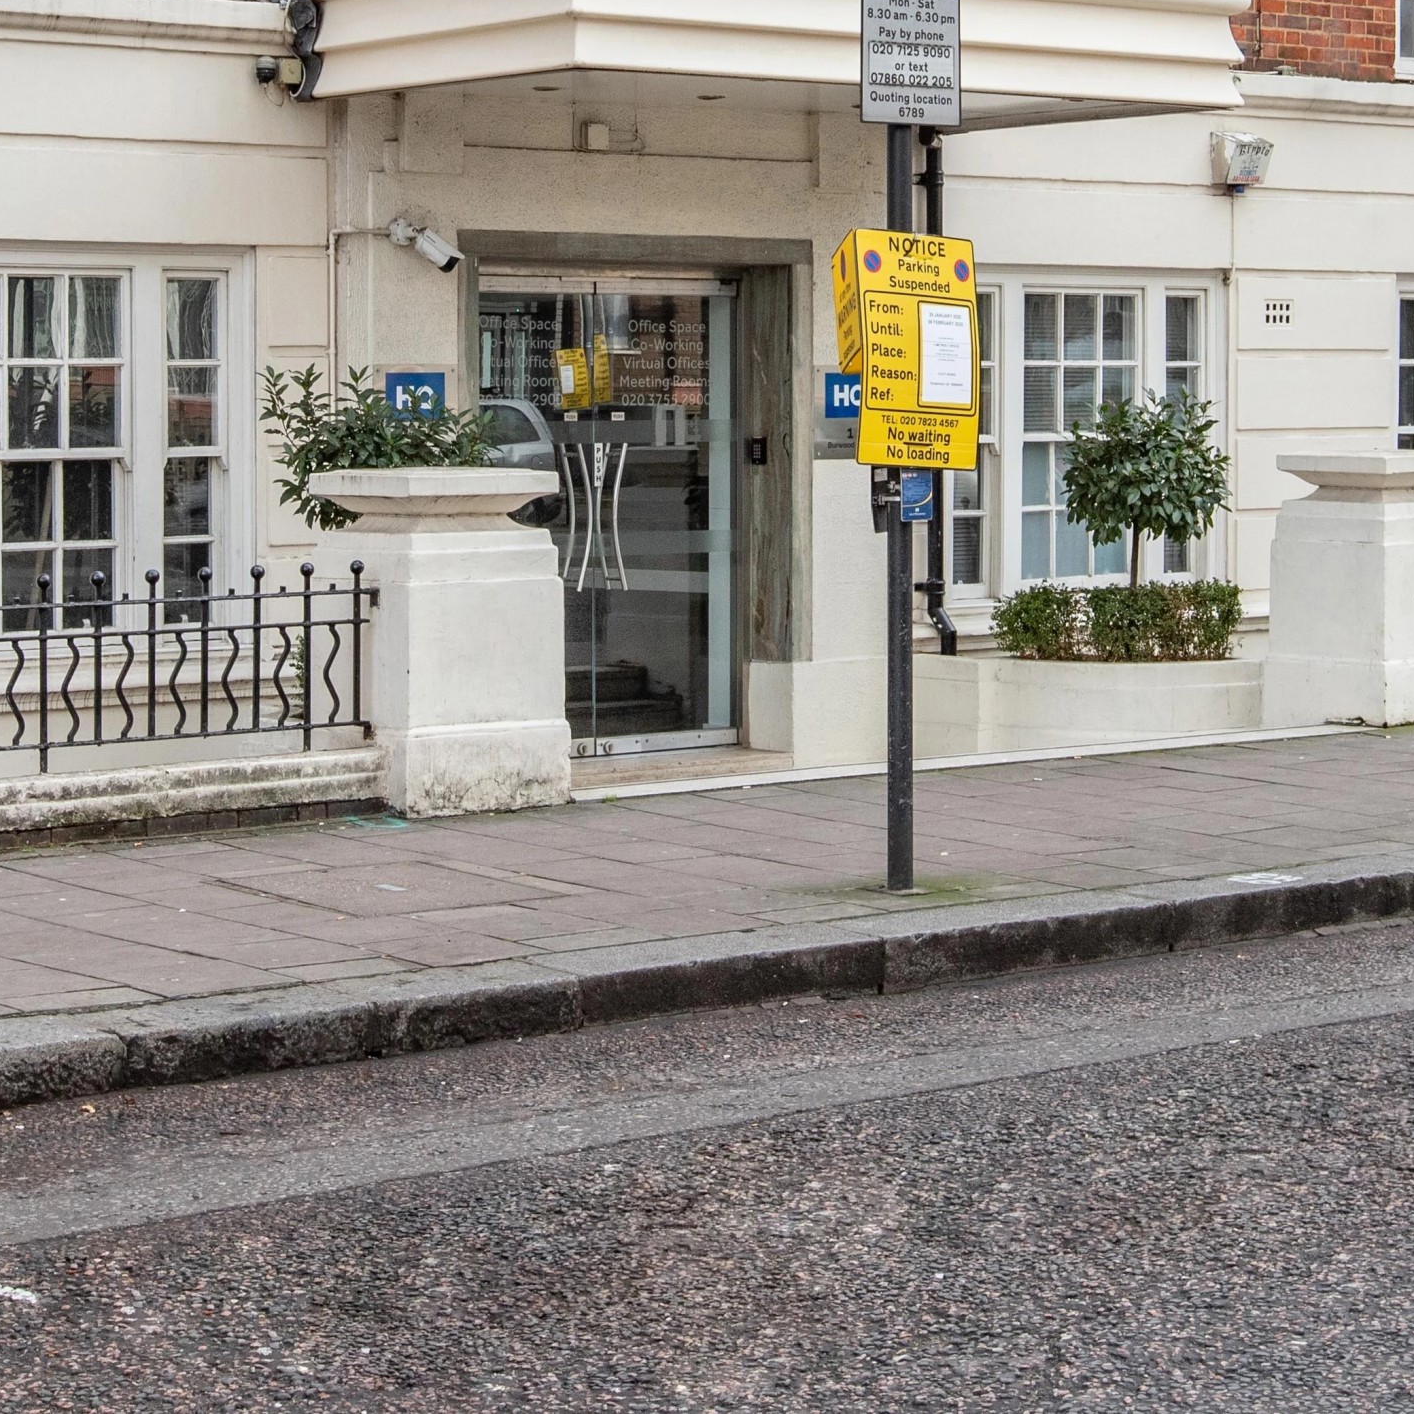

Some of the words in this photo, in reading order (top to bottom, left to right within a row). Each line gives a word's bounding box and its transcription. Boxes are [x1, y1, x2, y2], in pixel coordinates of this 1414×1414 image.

[867, 8, 891, 20] 8.30
[893, 13, 908, 21] am
[915, 11, 939, 24] 6.30
[940, 16, 956, 26] pm
[879, 27, 897, 40] Pay
[900, 28, 912, 41] by
[914, 29, 945, 42] phone
[872, 43, 894, 56] 020
[897, 45, 920, 57] 7125
[923, 47, 951, 59] 9090
[894, 62, 905, 71] or
[908, 62, 929, 73] text
[870, 72, 905, 85] 07860
[908, 74, 929, 87] 022
[932, 75, 953, 88] 205
[870, 91, 910, 105] Quoting
[913, 93, 952, 105] location
[898, 107, 925, 118] 6789
[888, 236, 947, 258] NOTICE
[898, 259, 940, 277] Parking
[889, 276, 951, 293] Suspended
[869, 299, 904, 315] From:
[479, 315, 517, 329] Office
[521, 317, 558, 334] Space
[628, 319, 666, 333] Office
[669, 320, 706, 336] Space
[870, 321, 903, 336] Until:
[631, 338, 704, 354] Co-Working
[871, 343, 907, 358] Place:
[623, 357, 665, 369] Virtual
[871, 364, 918, 382] Reason:
[620, 375, 670, 391] Meeting
[532, 394, 565, 406] 2900
[622, 394, 645, 406] 020
[649, 394, 678, 406] 3755
[682, 394, 711, 406] 2900
[871, 387, 895, 401] Ref:
[900, 416, 916, 425] 020
[918, 417, 937, 427] 7823
[939, 419, 959, 428] 4567
[887, 427, 905, 441] No
[907, 430, 951, 446] waiting
[886, 445, 904, 459] No
[907, 446, 950, 464] loading
